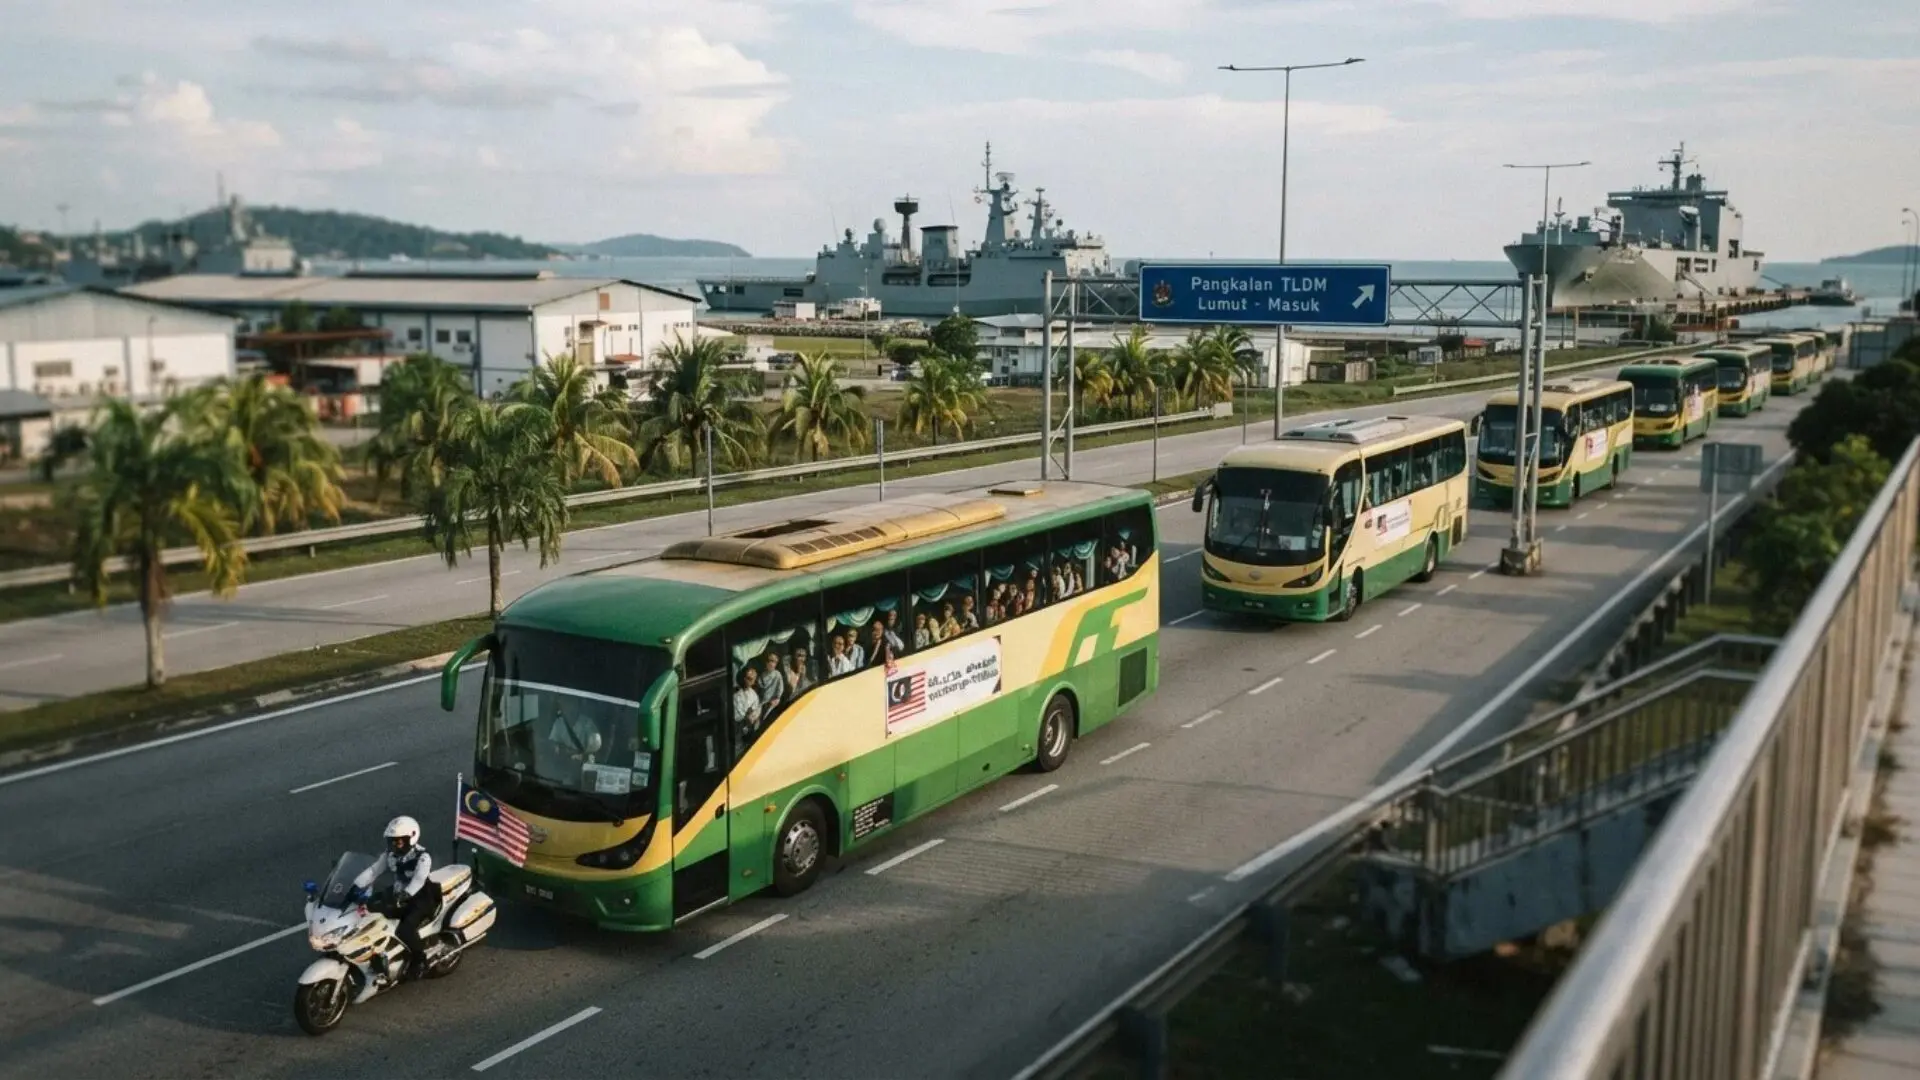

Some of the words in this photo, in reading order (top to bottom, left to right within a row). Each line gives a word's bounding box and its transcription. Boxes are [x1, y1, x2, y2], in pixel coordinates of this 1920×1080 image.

[1191, 276, 1273, 294] Pangkalan
[1281, 277, 1328, 292] TLDM
[1198, 297, 1248, 311] Lumut
[1267, 297, 1320, 312] Masuk
